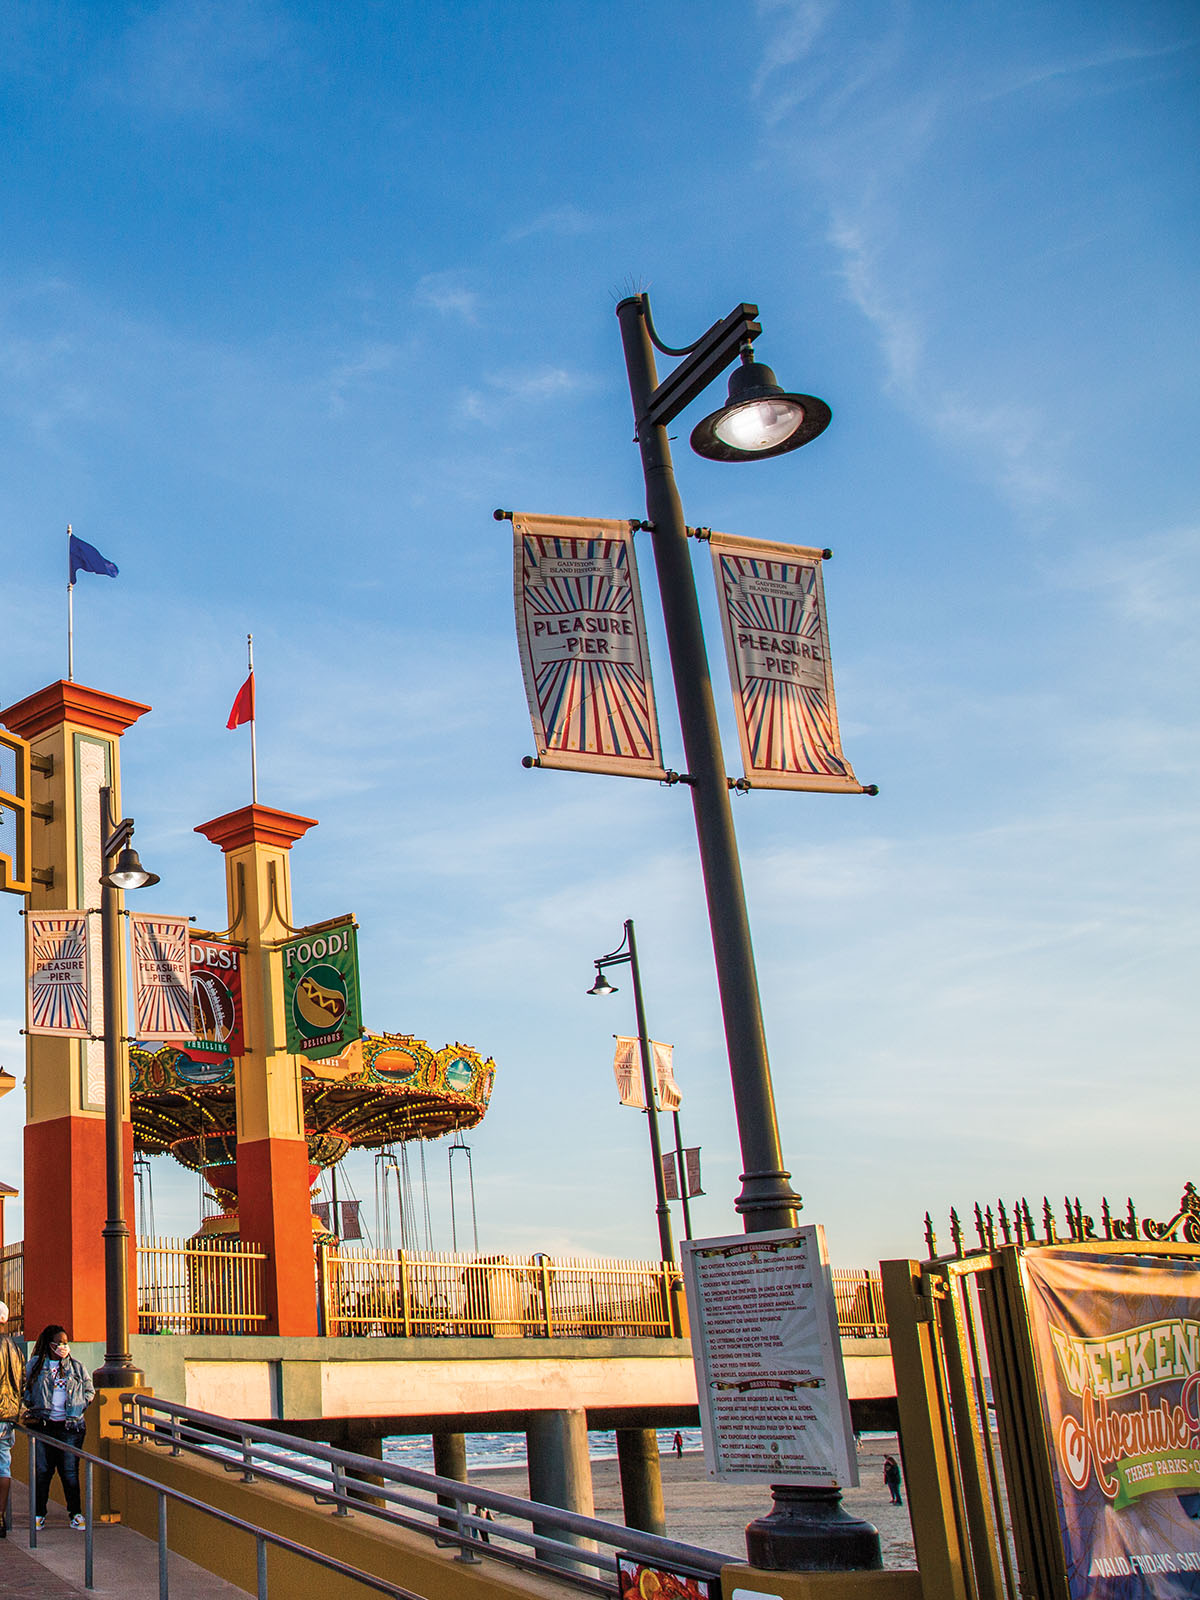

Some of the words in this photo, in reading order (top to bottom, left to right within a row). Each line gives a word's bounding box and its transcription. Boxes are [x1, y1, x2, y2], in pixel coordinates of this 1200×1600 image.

[533, 617, 634, 636] PLEASURE
[566, 637, 610, 654] PIER
[738, 633, 821, 661] PLEASURE
[765, 656, 801, 678] PIER
[190, 943, 238, 970] DES!
[285, 931, 350, 968] FOOD!
[36, 960, 84, 971] PLEASURE
[140, 962, 184, 973] PLEASURE
[50, 972, 71, 982] PIER
[152, 974, 172, 982] PIER
[303, 1032, 342, 1049] DELICIOUS
[1051, 1321, 1200, 1396] WEEKEN
[1124, 1461, 1155, 1484] THREE
[1156, 1458, 1189, 1478] PARKS
[1094, 1556, 1131, 1578] VALID
[1128, 1552, 1180, 1574] FRIDAYS,
